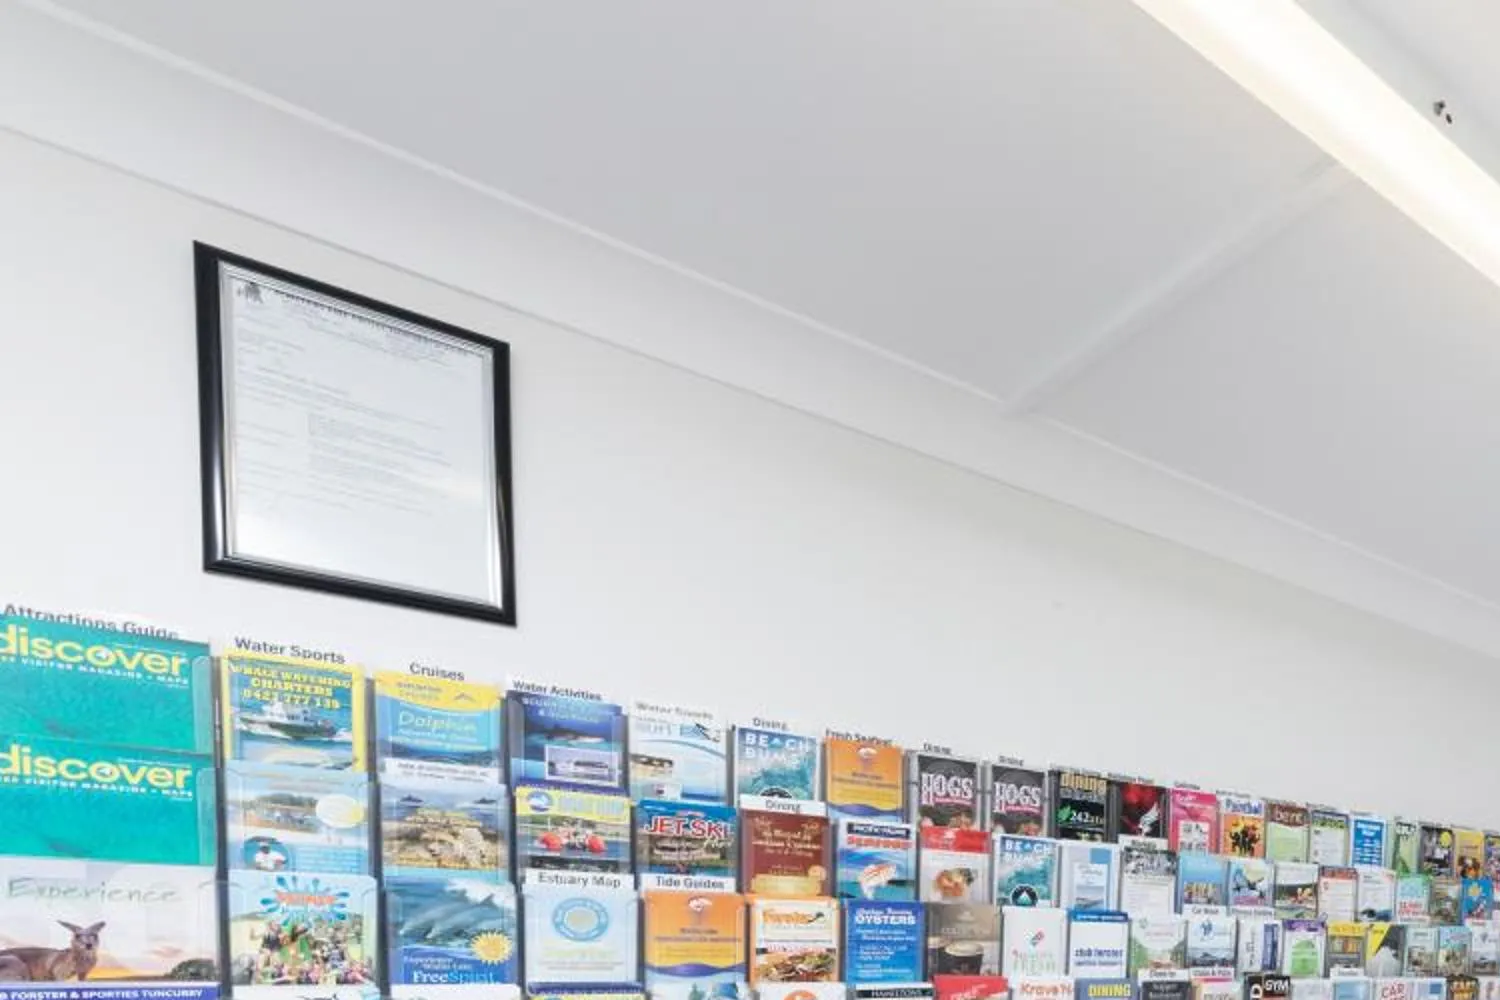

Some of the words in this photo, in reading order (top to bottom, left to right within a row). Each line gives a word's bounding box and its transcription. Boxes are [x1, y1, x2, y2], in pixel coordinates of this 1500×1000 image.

[0, 623, 187, 677] discover
[234, 636, 284, 656] Water
[290, 644, 346, 665] Sports
[409, 661, 465, 681] Cruises
[512, 679, 547, 694] Water
[550, 685, 602, 701] Activities
[0, 743, 192, 789] discover
[643, 815, 686, 836] JET
[689, 817, 731, 839] SKI
[8, 876, 181, 904] Experience
[538, 872, 588, 888] Estuary
[592, 874, 622, 889] Map
[655, 875, 681, 887] Tide
[683, 877, 725, 889] Guides
[11, 990, 69, 1000] FORSTER
